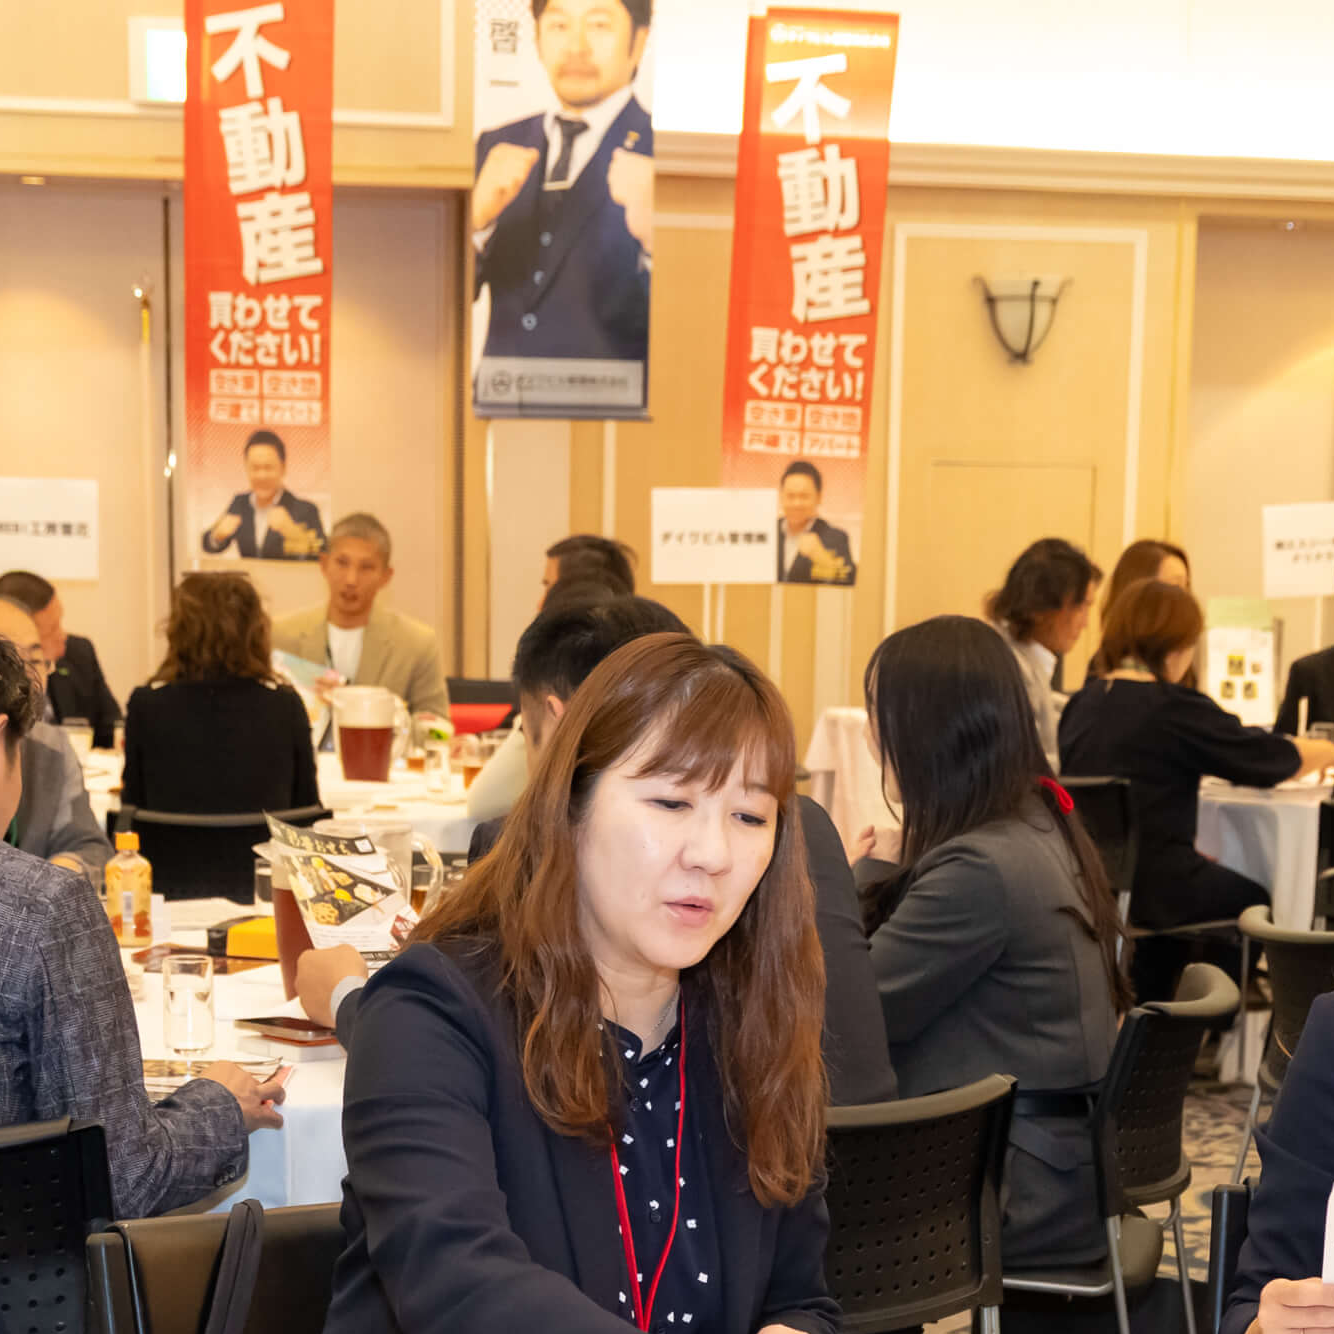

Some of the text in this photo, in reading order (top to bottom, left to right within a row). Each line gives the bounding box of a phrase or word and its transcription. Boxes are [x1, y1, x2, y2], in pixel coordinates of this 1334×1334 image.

[205, 5, 324, 286] 不動産
[765, 53, 872, 325] 不動産
[208, 291, 323, 330] 買わせて
[749, 326, 867, 368] 買わせて
